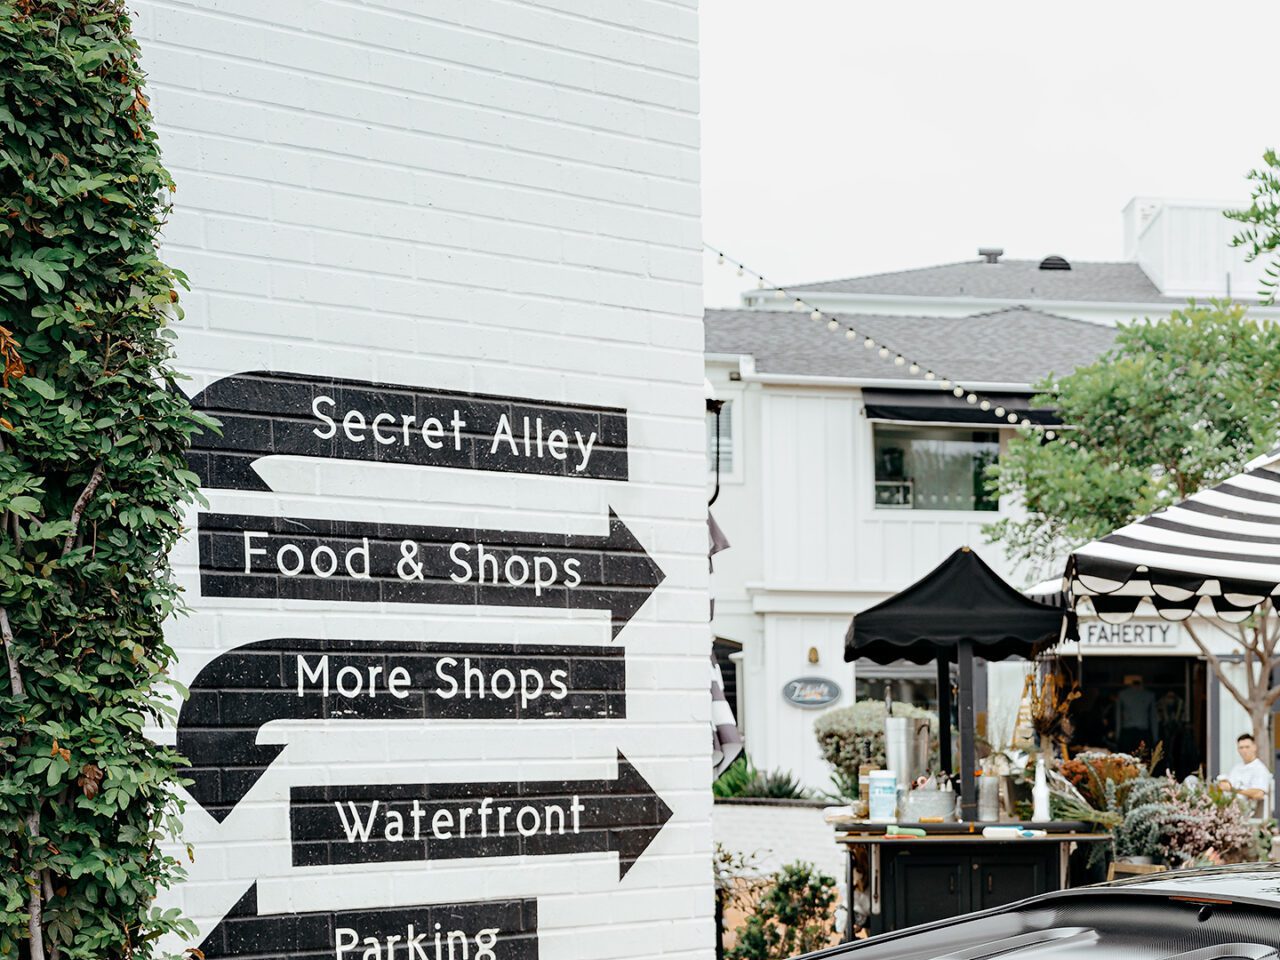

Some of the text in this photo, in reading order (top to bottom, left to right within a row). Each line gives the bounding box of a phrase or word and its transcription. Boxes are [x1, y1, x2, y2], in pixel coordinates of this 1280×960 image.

[311, 396, 598, 472] Secret Alley
[243, 532, 583, 597] Food & Shops
[1087, 624, 1170, 643] FAHERTY
[297, 654, 570, 708] More Shops
[334, 795, 586, 843] Waterfront
